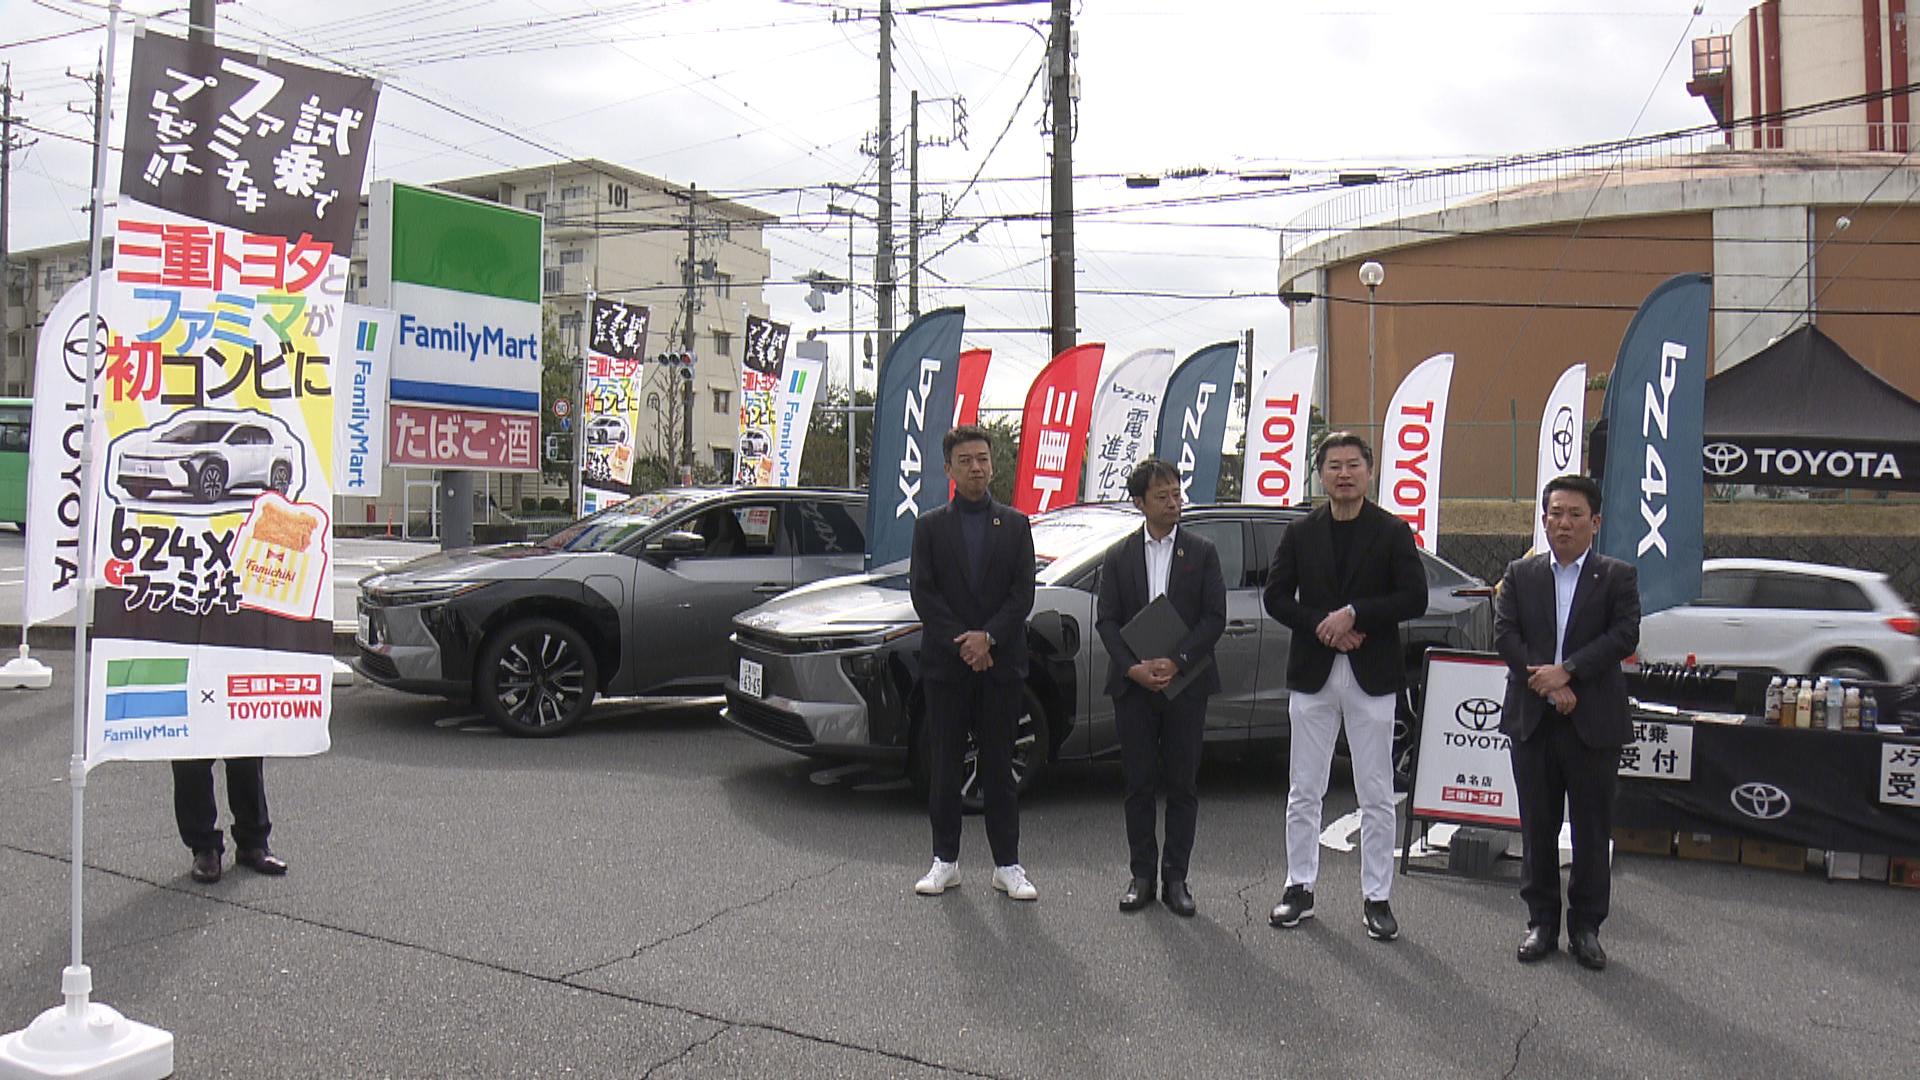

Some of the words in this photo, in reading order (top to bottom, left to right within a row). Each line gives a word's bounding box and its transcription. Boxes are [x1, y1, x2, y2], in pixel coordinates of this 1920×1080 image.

[206, 57, 286, 213] ファミチキ
[273, 94, 364, 219] 試乗で
[608, 182, 628, 209] 101
[117, 219, 346, 294] 三重トヨタと
[133, 288, 335, 355] ファミマが
[399, 313, 538, 362] FamilyMart
[106, 336, 332, 405] 初コンビに
[347, 359, 372, 488] FamilyMart
[395, 412, 532, 465] たばこ・酒
[1257, 394, 1300, 507] TOYO
[1754, 448, 1902, 479] TOYOTA
[123, 571, 243, 614] ファミチキ
[103, 724, 189, 742] FamilyMart
[227, 700, 322, 720] TOYOTOWN
[1443, 732, 1512, 751] TOYOTA
[1619, 746, 1679, 773] 受付
[1887, 772, 1916, 799] 受
